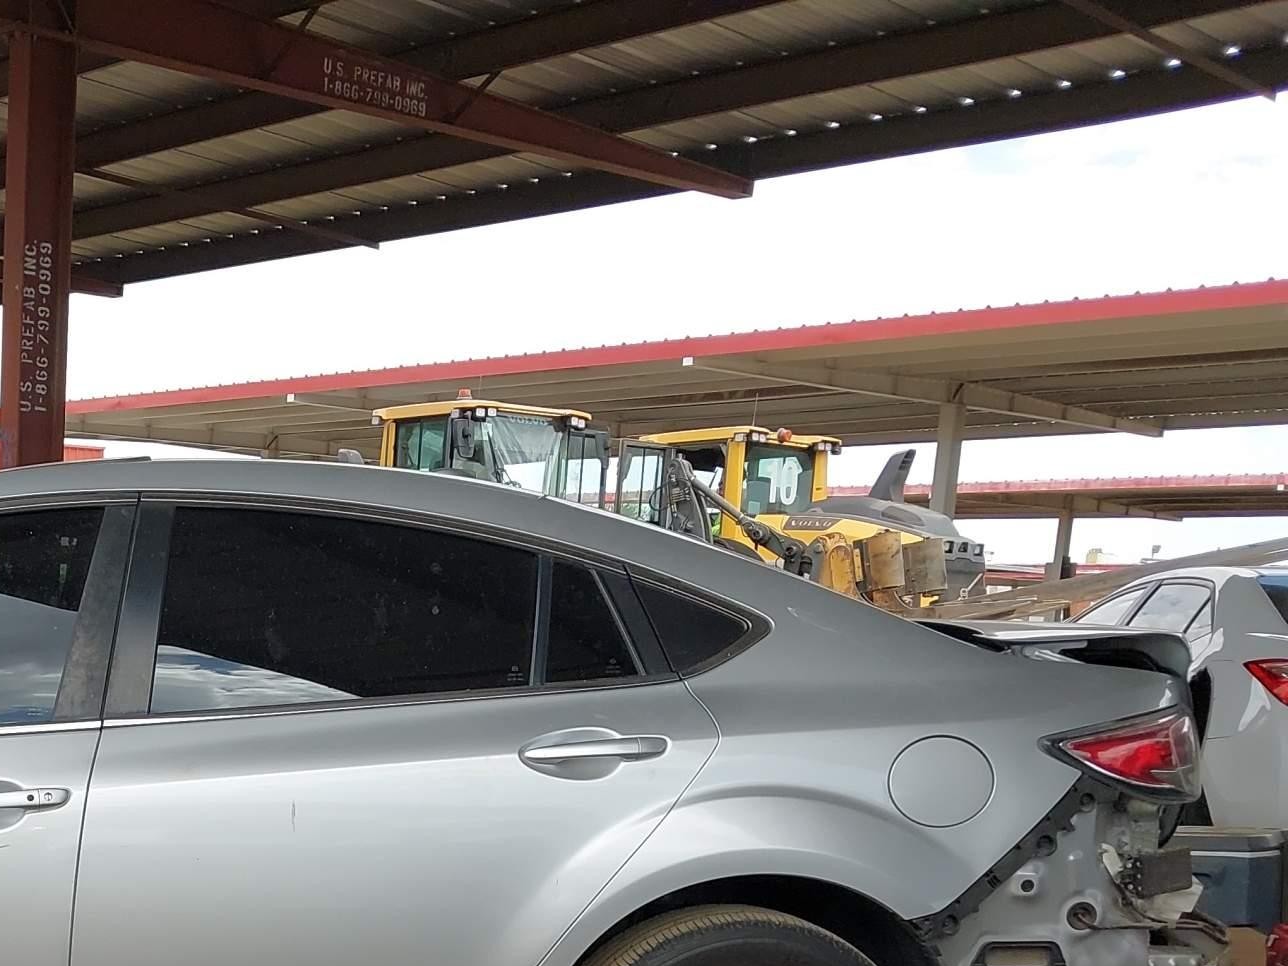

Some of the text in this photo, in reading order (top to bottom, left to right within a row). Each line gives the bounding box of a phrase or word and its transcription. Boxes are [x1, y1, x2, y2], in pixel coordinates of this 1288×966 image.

[323, 77, 427, 118] 1-866-799-0969
[353, 65, 401, 92] PREFAB
[405, 79, 429, 100] INC.
[20, 239, 38, 412] U.S. PREFAB INC.
[34, 242, 53, 412] 1-866-799-0969
[790, 519, 832, 527] VOLVO
